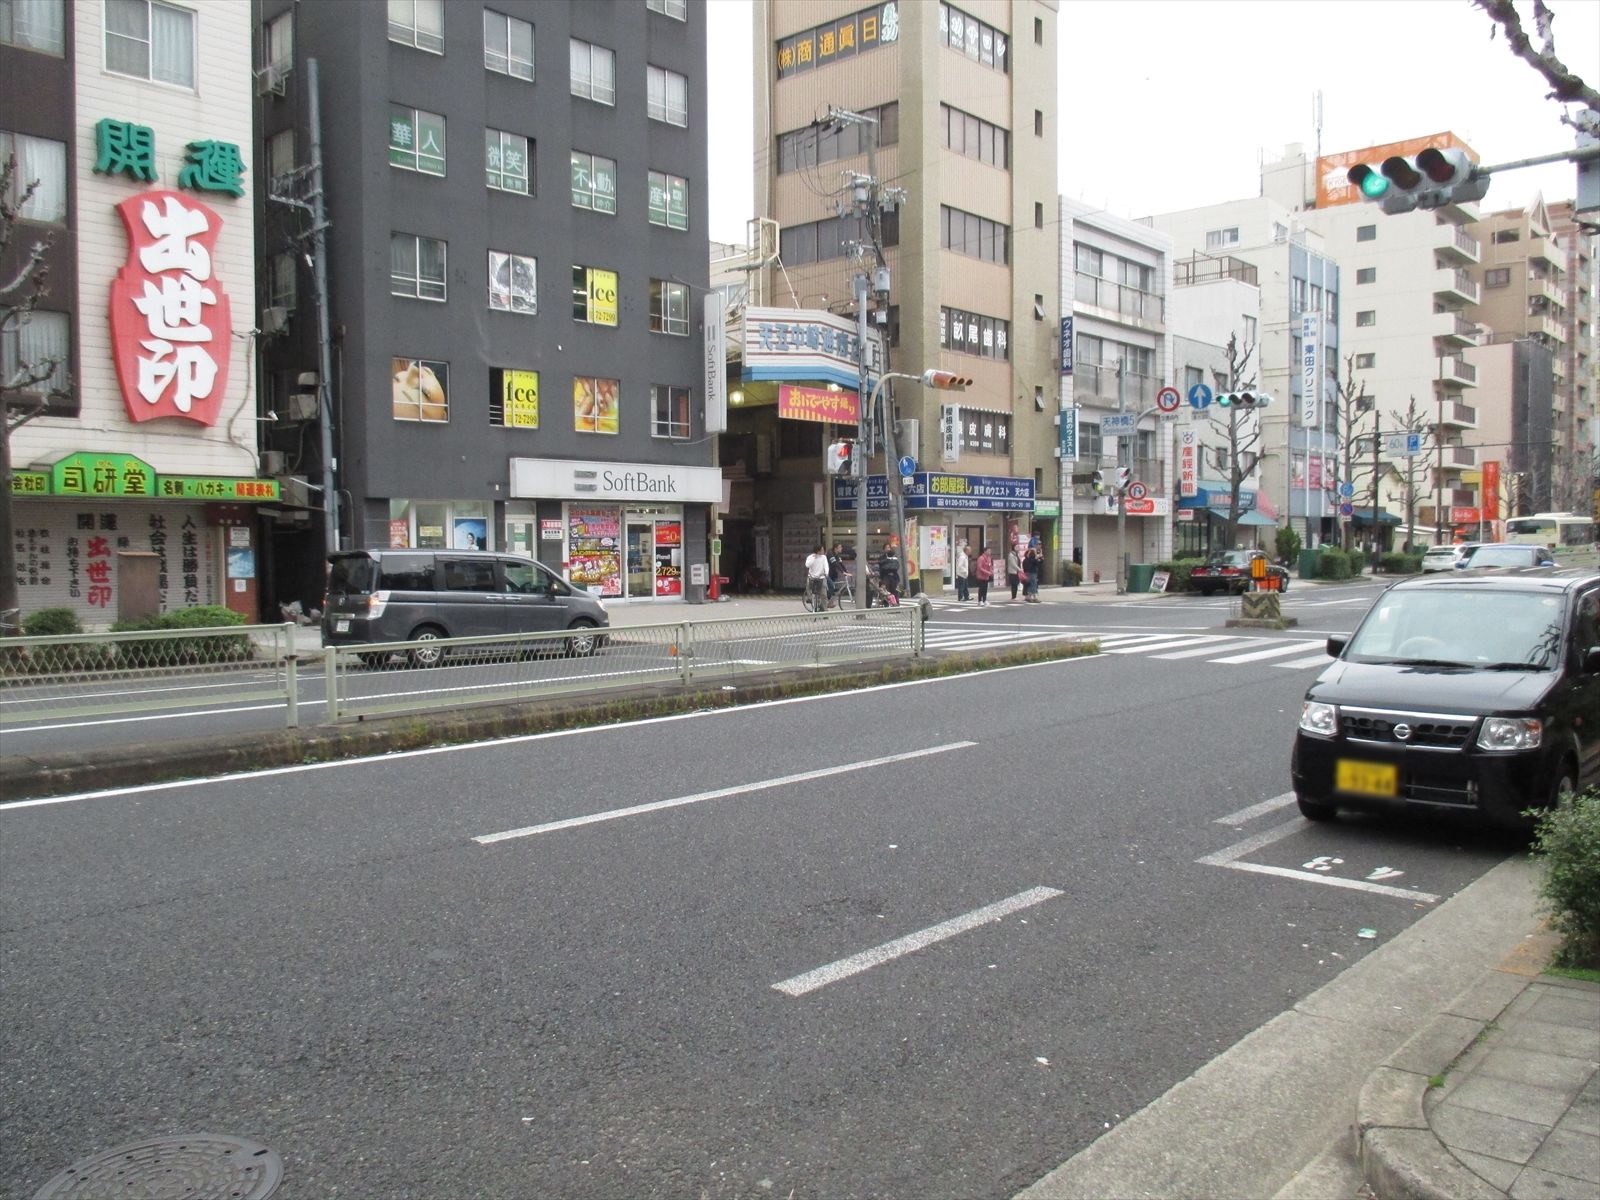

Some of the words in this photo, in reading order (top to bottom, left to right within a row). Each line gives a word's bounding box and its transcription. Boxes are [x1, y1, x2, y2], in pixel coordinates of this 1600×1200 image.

[92, 117, 248, 198] 開運
[131, 196, 219, 413] 出世印
[708, 345, 716, 400] SoftBank
[64, 466, 146, 494] 司研堂
[603, 470, 676, 493] SoftBank
[931, 477, 972, 494] お部屋探し
[86, 536, 113, 608] 出世印
